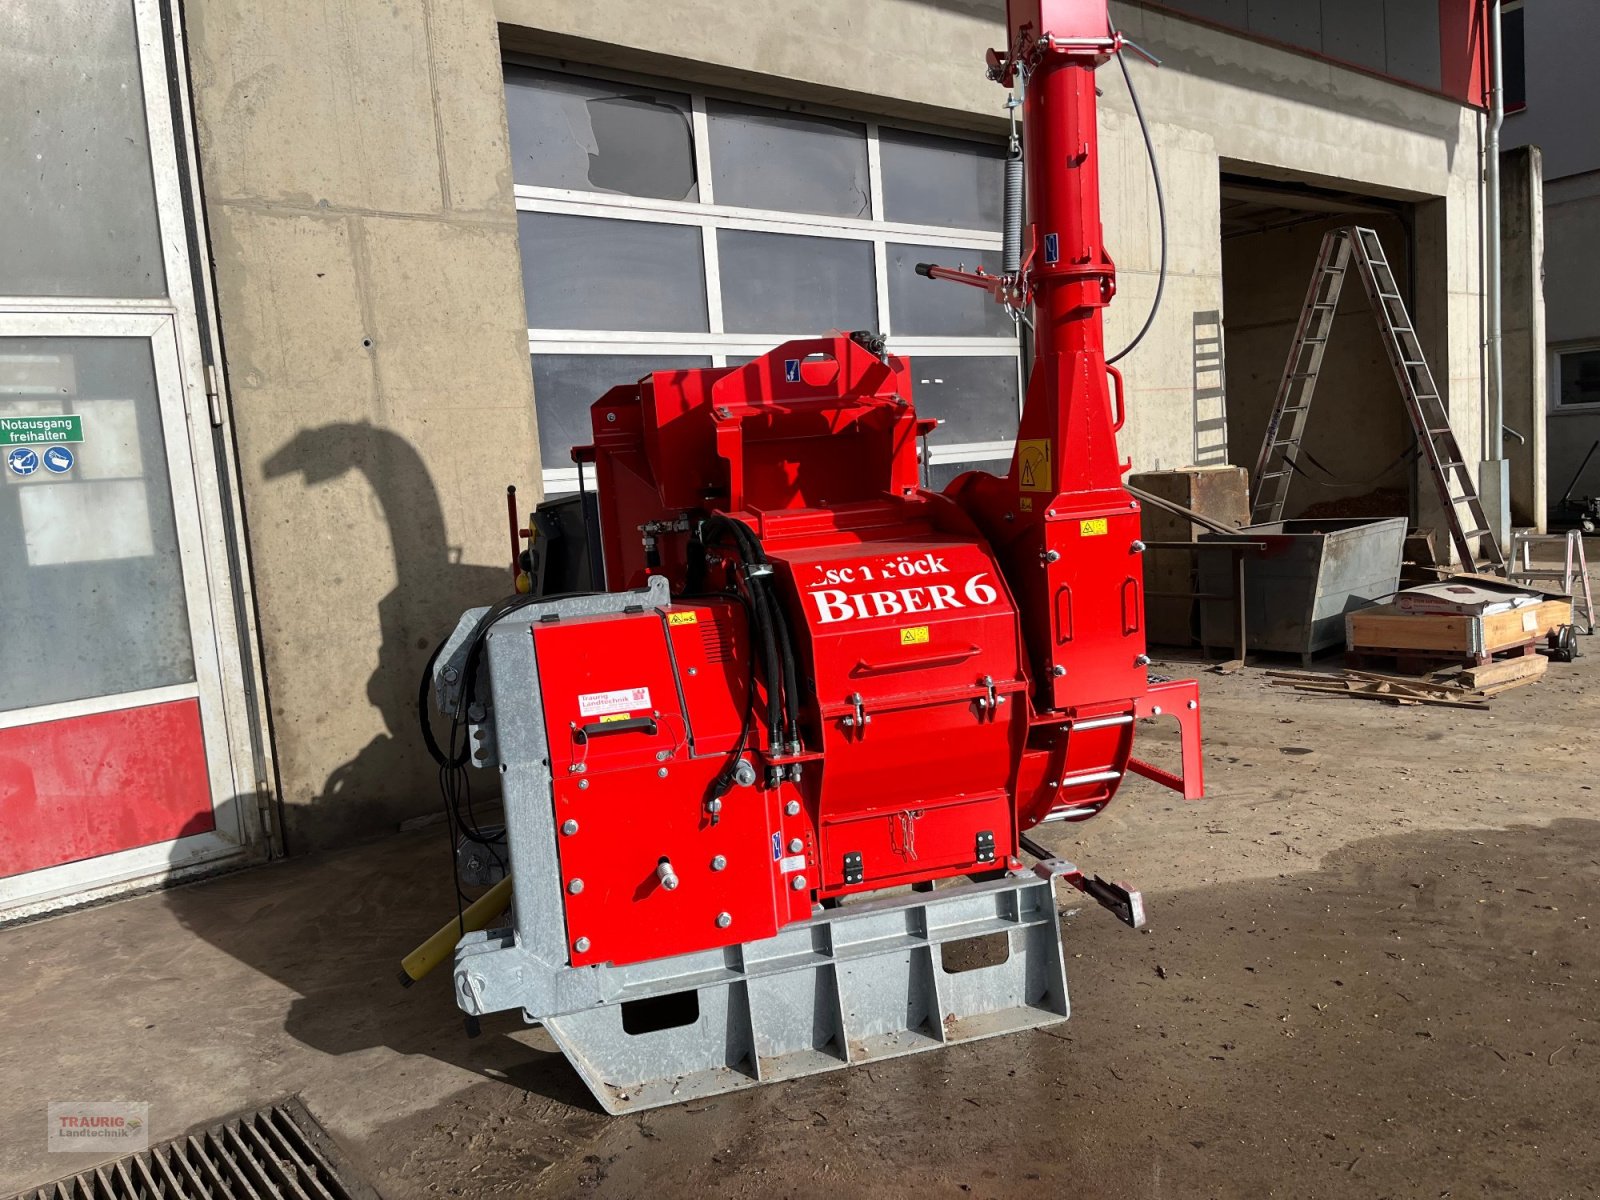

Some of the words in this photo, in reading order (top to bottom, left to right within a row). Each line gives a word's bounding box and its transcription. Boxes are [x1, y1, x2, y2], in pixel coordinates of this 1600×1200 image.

[1, 419, 72, 430] Notausgang
[9, 431, 67, 442] freihalten
[964, 572, 997, 605] 6
[582, 697, 629, 707] Landtechnik
